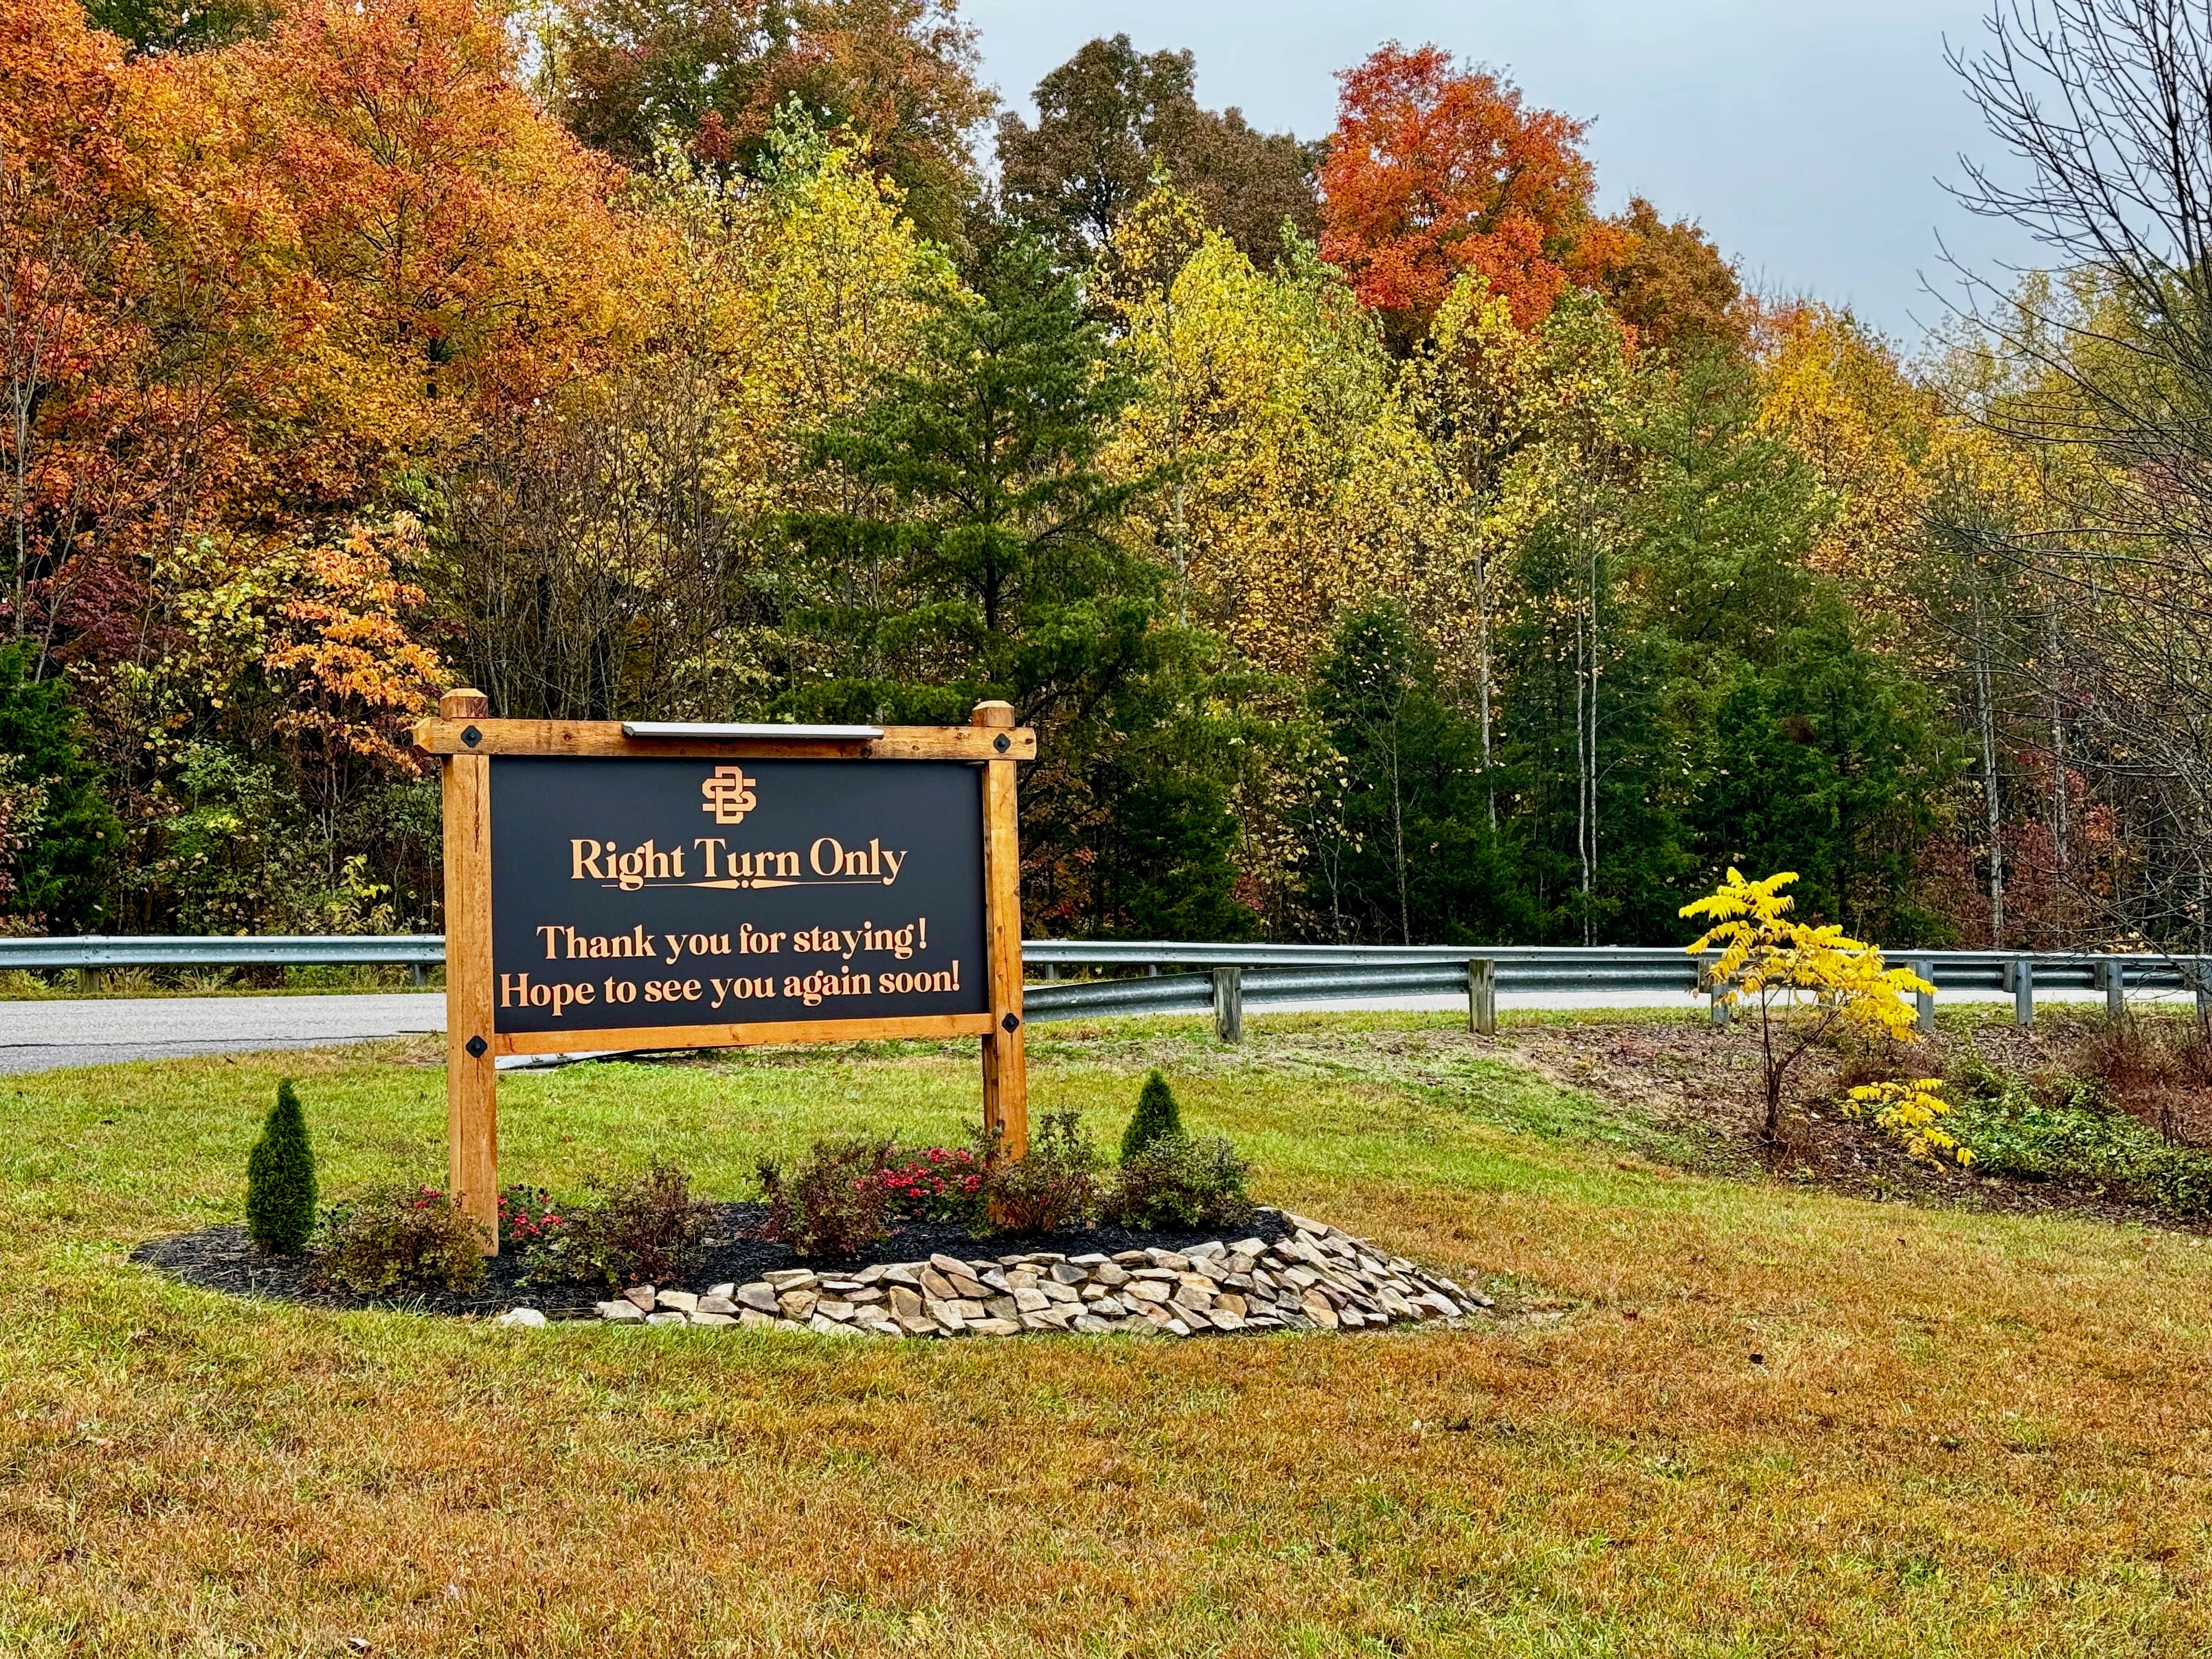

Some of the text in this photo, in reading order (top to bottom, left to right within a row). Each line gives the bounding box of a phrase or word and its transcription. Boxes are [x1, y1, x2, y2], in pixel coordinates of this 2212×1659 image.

[570, 837, 908, 891] Right Turn Only
[536, 917, 927, 965] Thank you for staying!
[500, 960, 960, 1017] Hope to see you again soon!
